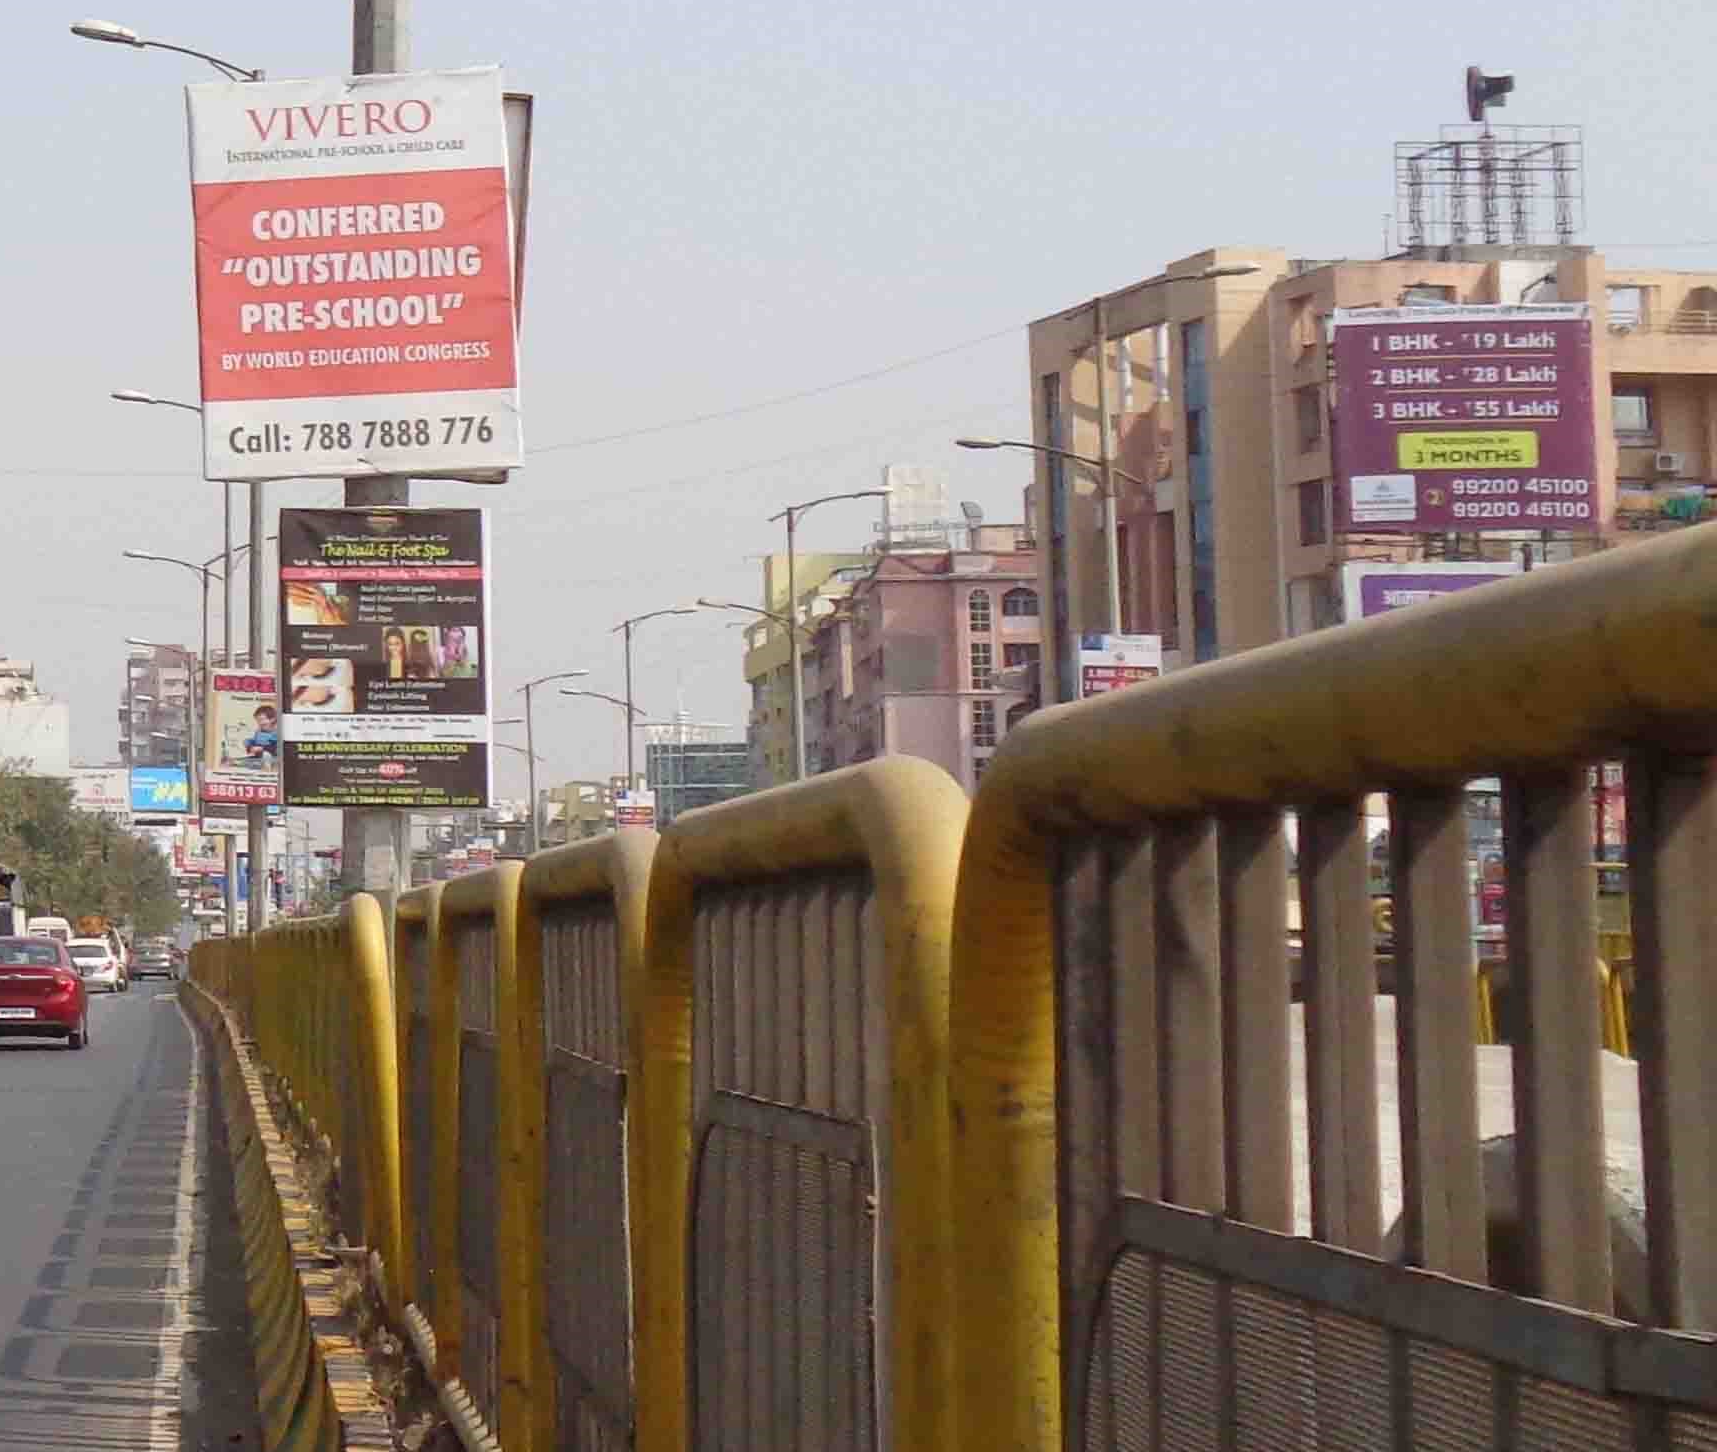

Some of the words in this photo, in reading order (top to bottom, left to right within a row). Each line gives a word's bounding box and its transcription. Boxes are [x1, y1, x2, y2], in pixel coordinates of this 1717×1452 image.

[246, 99, 433, 142] VIVERO
[252, 202, 445, 242] CONFERRED
[1388, 333, 1440, 351] BHK
[1503, 331, 1557, 349] Lakh
[221, 352, 242, 371] BY
[246, 349, 304, 370] WORLD
[309, 344, 400, 367] EDUCATION
[404, 341, 491, 362] CONGRESS
[1372, 370, 1385, 385] 2
[1390, 368, 1441, 385] BHK
[1505, 365, 1558, 383] Lakh
[1373, 403, 1385, 419] 3
[1392, 401, 1443, 418] BHK
[1506, 399, 1560, 417] Lakh
[228, 423, 292, 454] Call:
[301, 422, 352, 452] 788
[362, 419, 431, 449] 7888
[441, 416, 494, 446] 776
[1429, 449, 1523, 463] MONTHS
[1452, 479, 1520, 496] 99200
[1453, 502, 1521, 518] 99200
